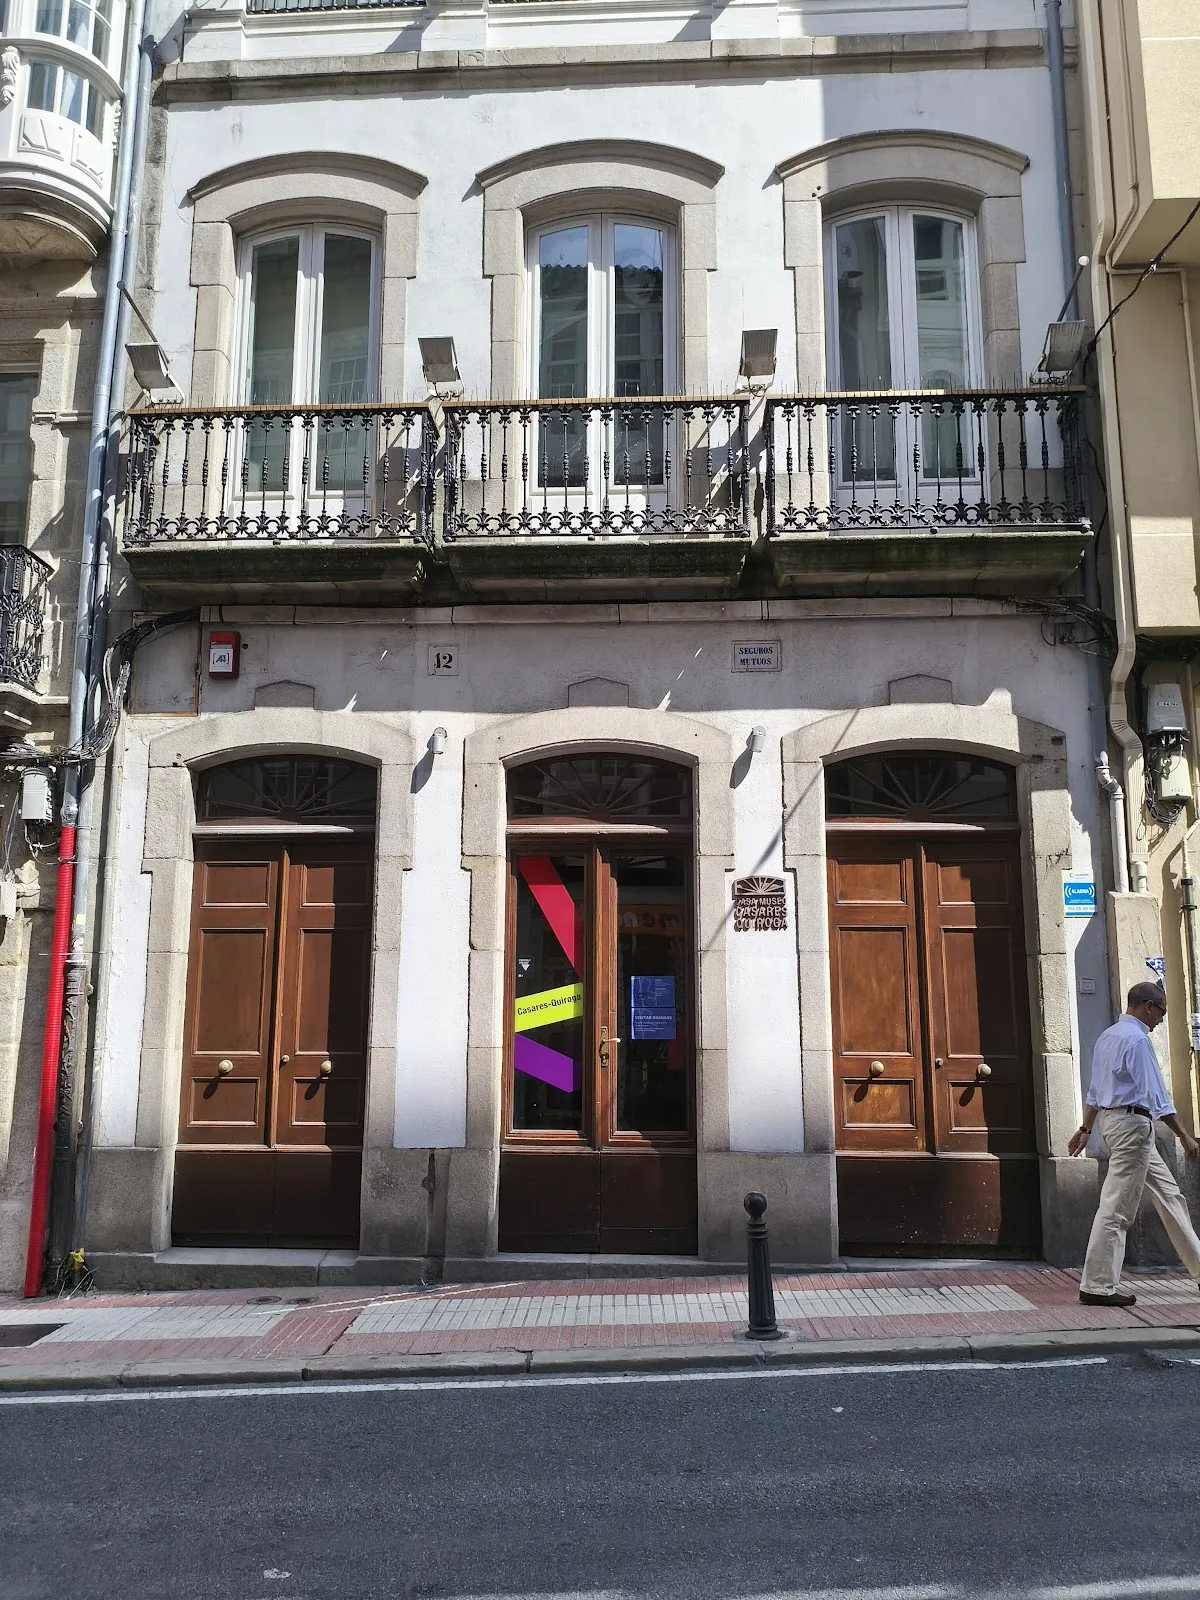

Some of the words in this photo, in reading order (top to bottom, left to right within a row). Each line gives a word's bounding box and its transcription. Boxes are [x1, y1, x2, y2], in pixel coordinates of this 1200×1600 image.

[738, 646, 773, 655] SEGUROS
[435, 653, 453, 669] 12
[740, 657, 772, 666] MUTUOS
[759, 897, 787, 906] MUSEO
[735, 906, 788, 917] CASARES
[736, 917, 788, 929] QUIROGA
[517, 994, 582, 1016] Casares-Quiroga
